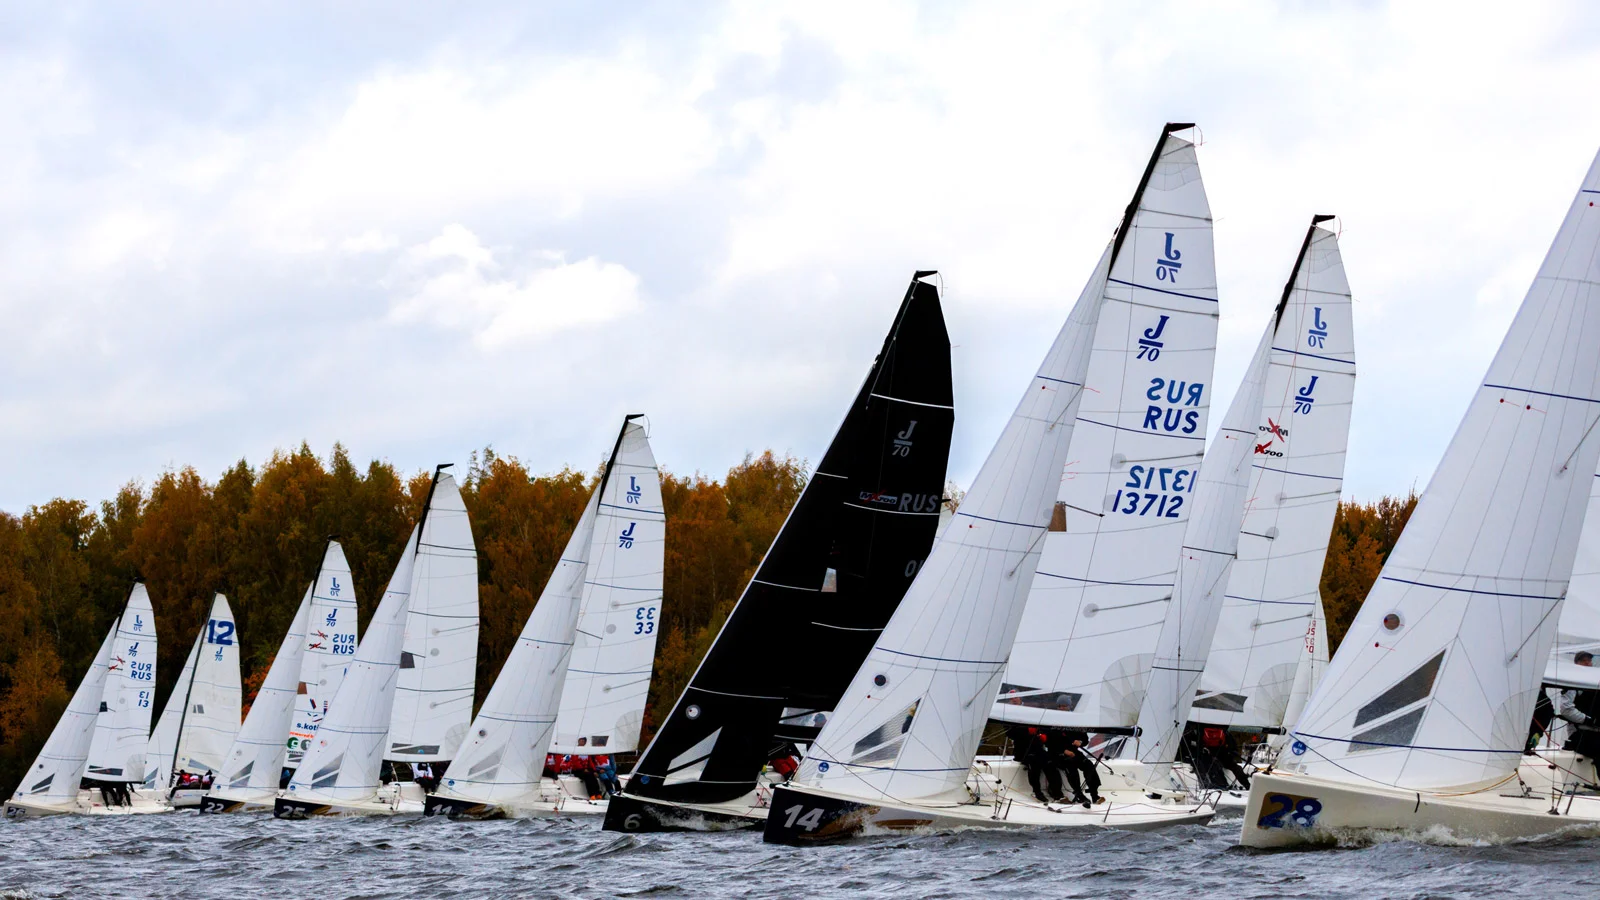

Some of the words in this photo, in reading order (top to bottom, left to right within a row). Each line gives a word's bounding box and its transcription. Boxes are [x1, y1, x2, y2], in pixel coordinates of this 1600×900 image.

[1144, 314, 1170, 340] J
[1136, 345, 1160, 362] 70
[1298, 375, 1319, 397] J
[1293, 401, 1312, 415] 70
[1143, 405, 1199, 434] RUS
[892, 444, 911, 458] 70
[898, 492, 939, 513] RUS
[1111, 489, 1184, 518] 13712
[619, 540, 633, 549] 70
[208, 619, 235, 646] 12
[634, 621, 655, 635] 33
[332, 644, 355, 655] RUS
[130, 670, 152, 681] RUS
[138, 699, 149, 708] 13
[204, 801, 225, 813] 22
[282, 805, 306, 817] 25
[1257, 794, 1323, 828] 28
[624, 813, 642, 830] 6
[783, 804, 825, 832] 14
